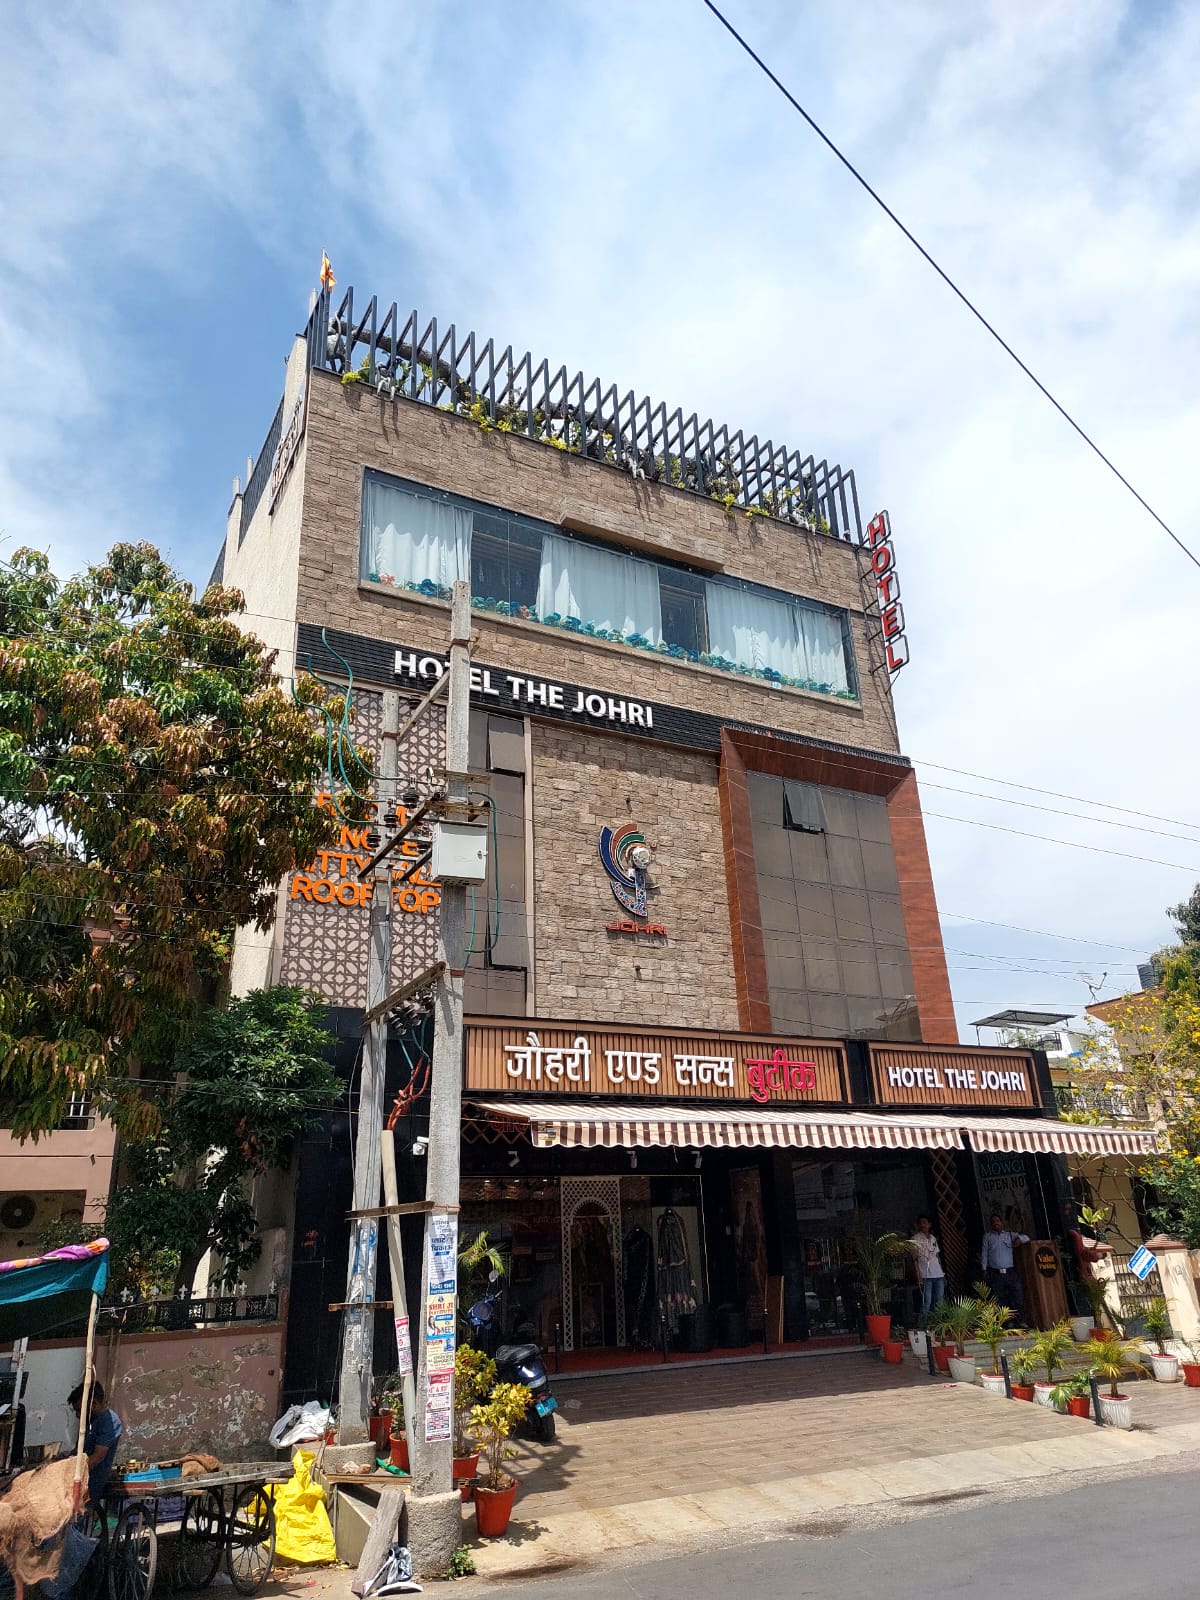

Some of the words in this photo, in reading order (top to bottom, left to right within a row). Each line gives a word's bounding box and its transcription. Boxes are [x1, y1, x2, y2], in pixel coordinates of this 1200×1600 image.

[868, 514, 904, 669] HOTEL
[394, 650, 499, 696] HOEL
[506, 675, 564, 710] THE
[572, 691, 654, 728] JOHRI
[504, 1031, 592, 1083] जौहरी
[604, 1050, 661, 1085] एण्ड
[673, 1053, 735, 1088] सन्स
[745, 1049, 817, 1103] बुटीक
[888, 1065, 943, 1089] HOTEL
[944, 1068, 978, 1090] THE
[980, 1070, 1026, 1092] JOHRI
